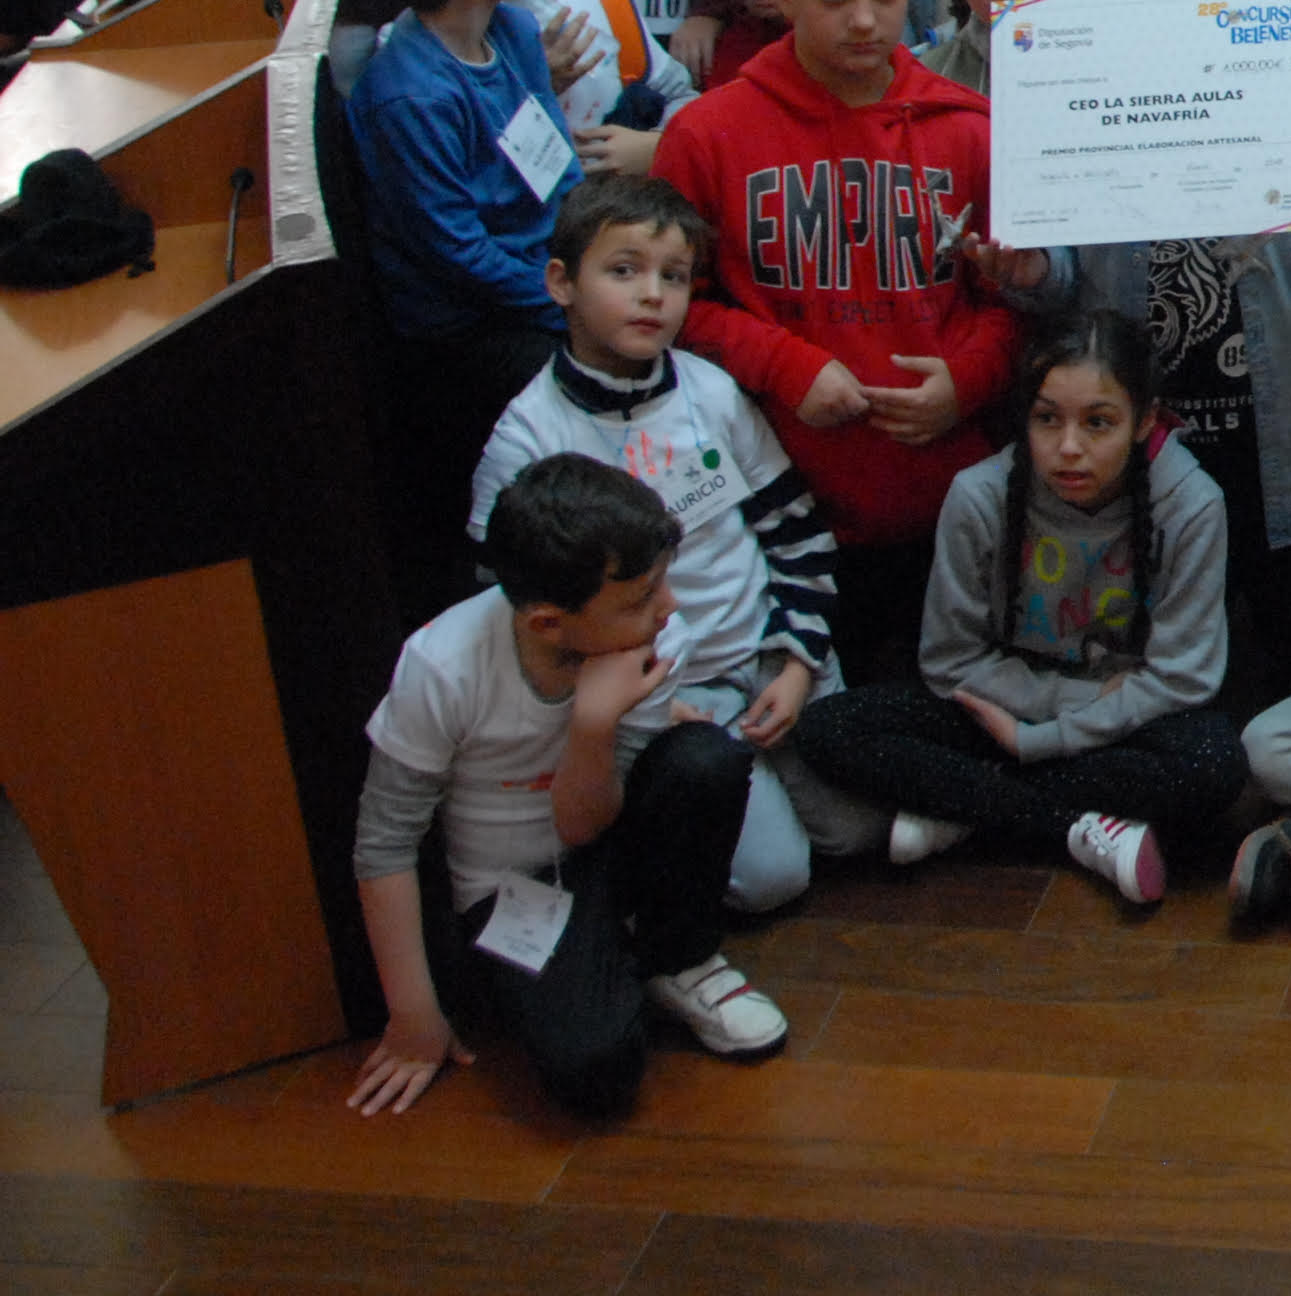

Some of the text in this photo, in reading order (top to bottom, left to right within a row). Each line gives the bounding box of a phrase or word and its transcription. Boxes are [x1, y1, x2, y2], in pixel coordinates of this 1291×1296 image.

[1068, 89, 1244, 111] CEO LA SIERRA AULAS
[1101, 108, 1211, 126] DE NAVAFRÍA
[1041, 147, 1076, 157] PREMIO
[1079, 143, 1134, 154] PROVINCIAL
[1207, 135, 1263, 146] ARTESANAL
[746, 158, 954, 291] EMPIRE
